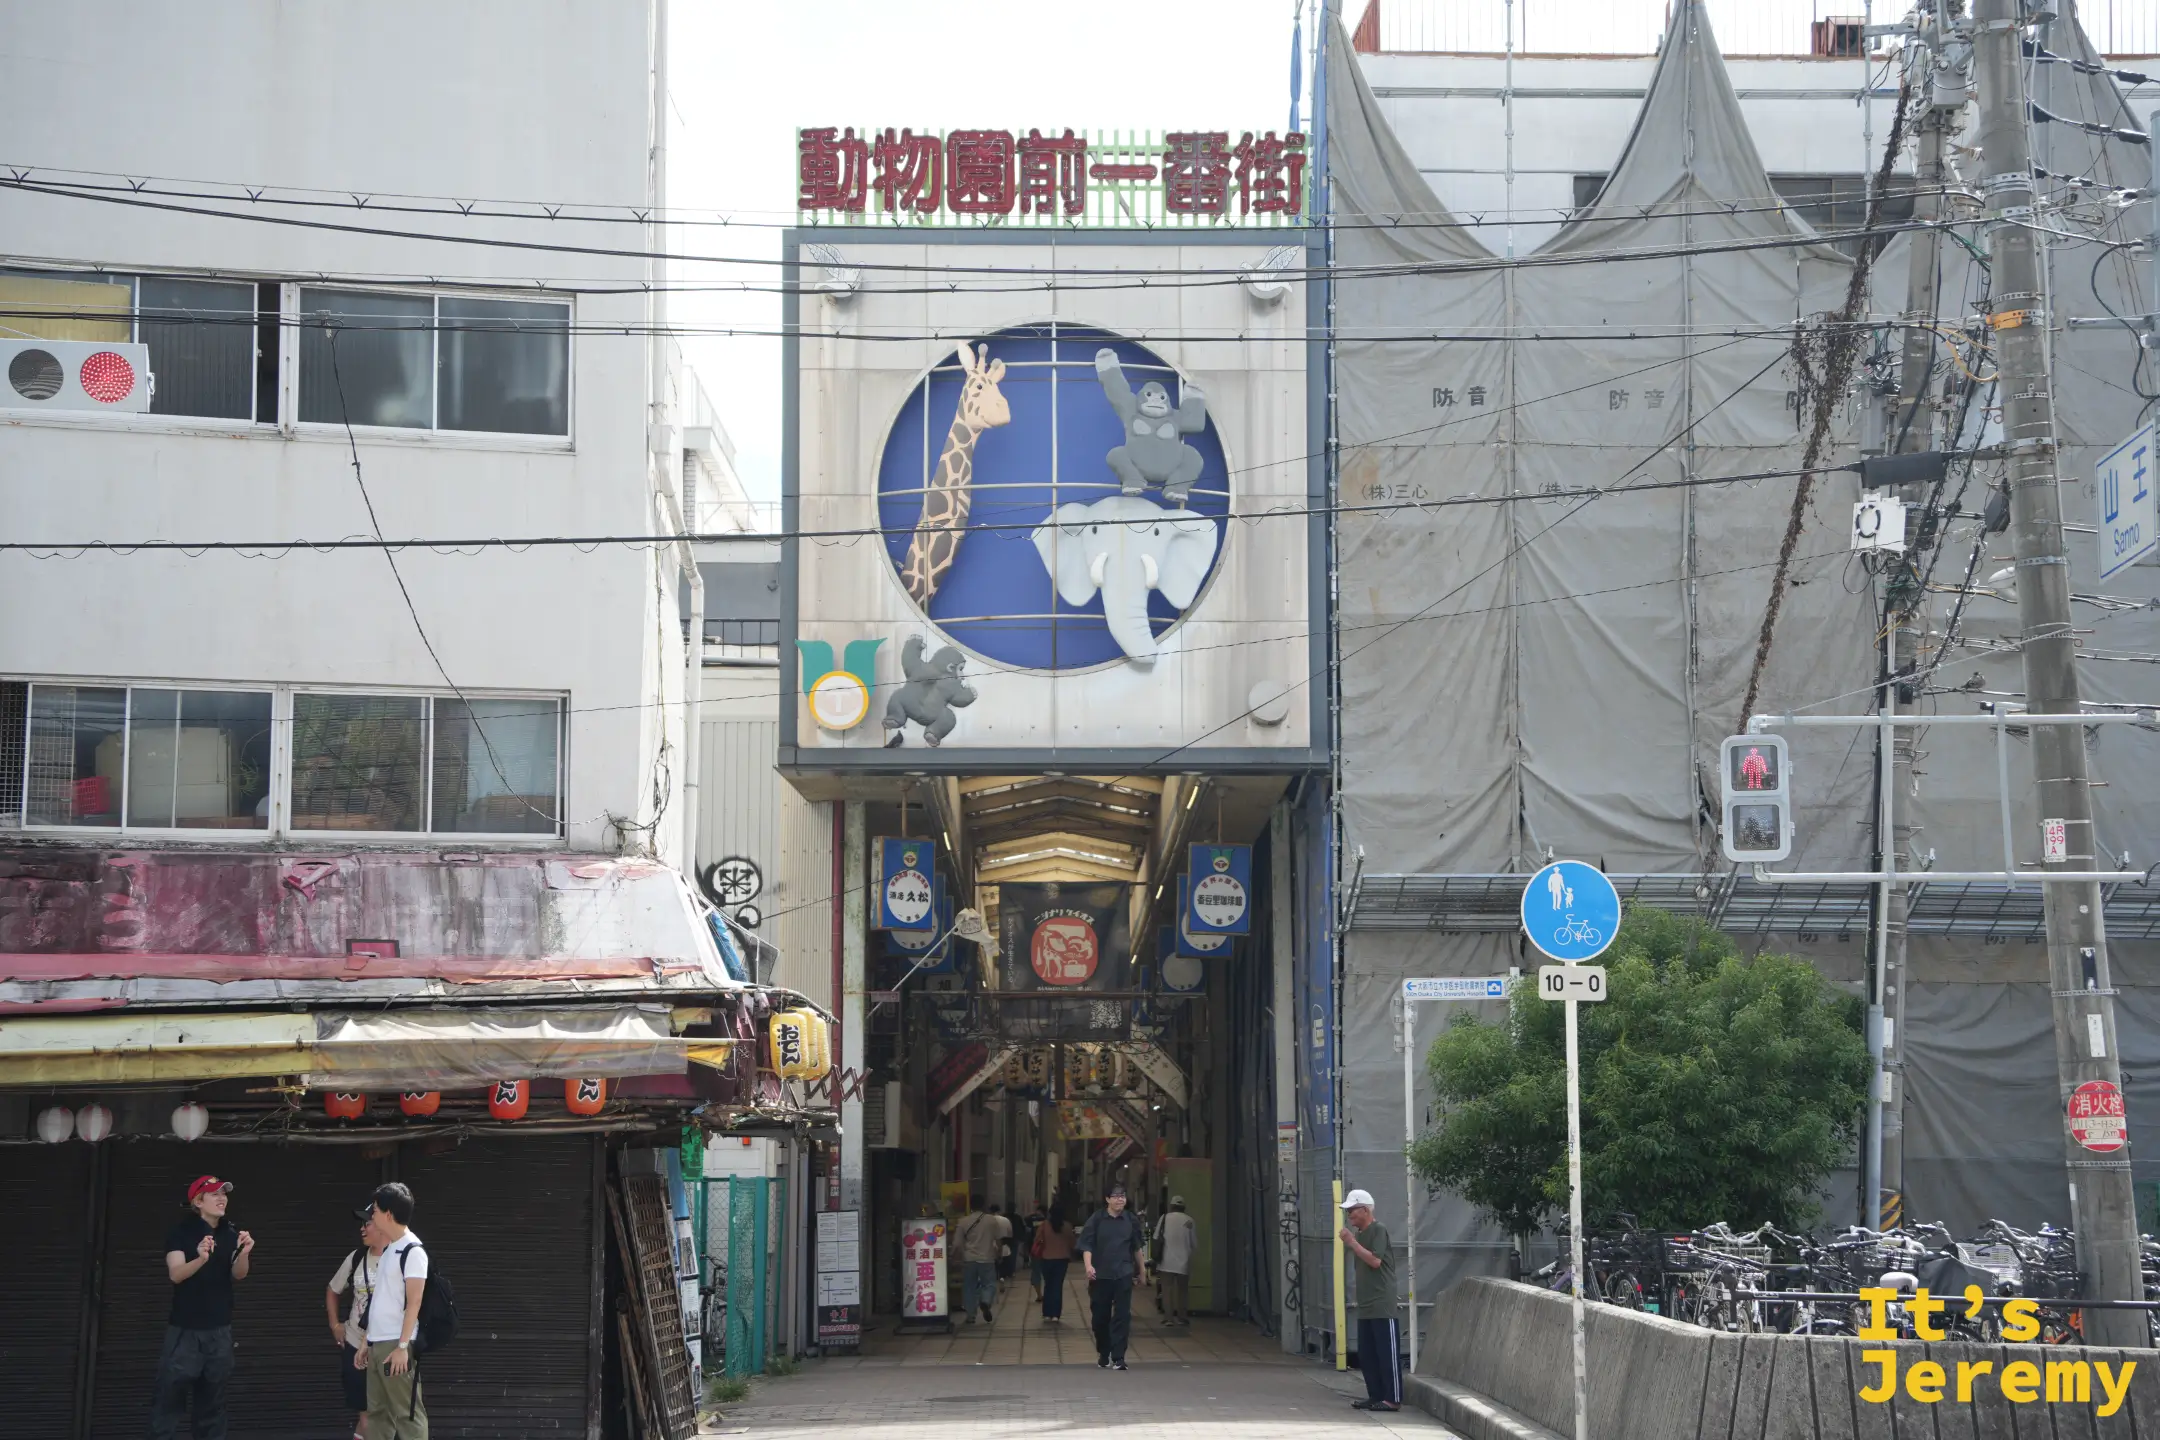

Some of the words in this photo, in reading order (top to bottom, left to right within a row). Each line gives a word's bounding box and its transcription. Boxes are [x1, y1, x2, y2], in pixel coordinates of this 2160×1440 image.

[798, 126, 1306, 216] 動物園前一番街
[1432, 386, 1487, 408] 防音
[1609, 389, 1664, 410] 防音
[1361, 483, 1428, 500] (株)三心
[2103, 445, 2147, 524] 山王
[2113, 522, 2140, 557] Sanno
[2051, 846, 2057, 855] A
[906, 890, 929, 903] 久松
[776, 1023, 801, 1067] おでん
[2075, 1094, 2123, 1116] 消火栓
[905, 1247, 944, 1260] 居酒屋
